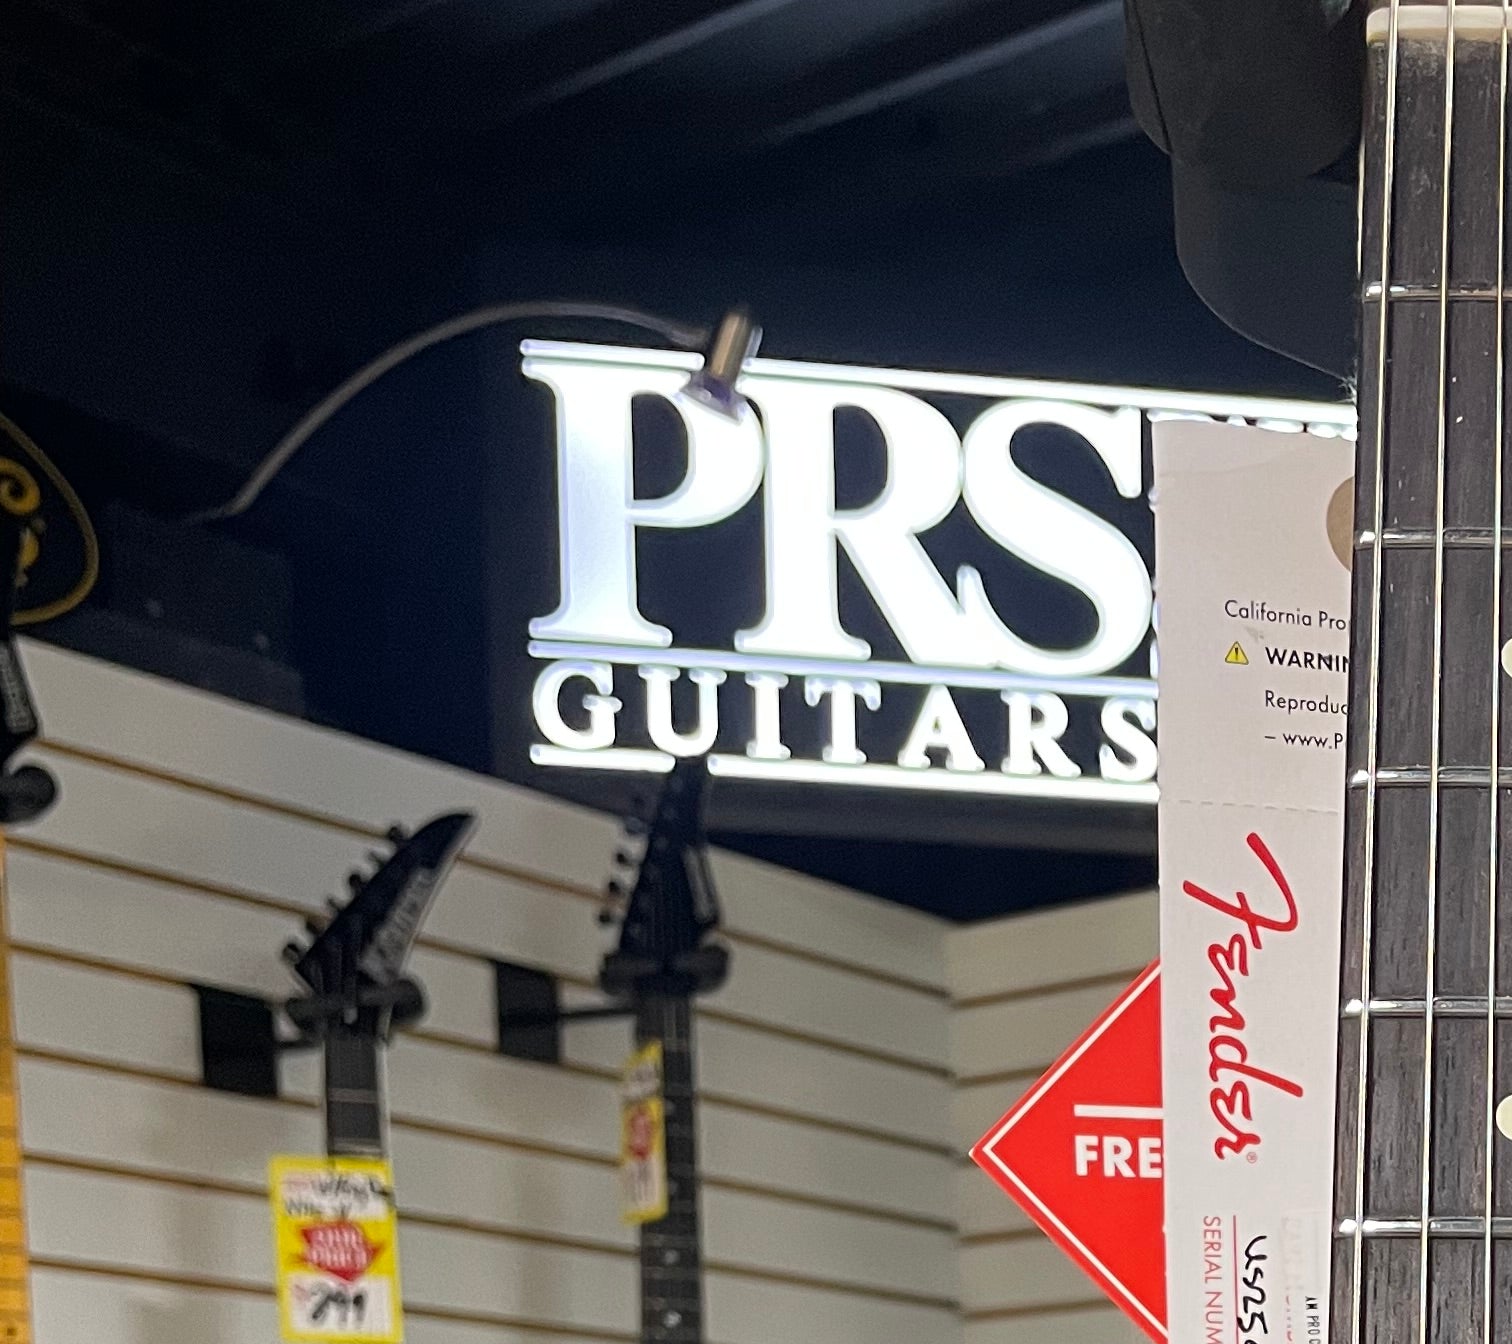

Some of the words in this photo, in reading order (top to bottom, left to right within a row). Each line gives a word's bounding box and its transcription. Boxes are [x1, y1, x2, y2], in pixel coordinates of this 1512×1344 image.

[521, 354, 1153, 678] PRS
[1224, 599, 1313, 627] California
[1318, 610, 1350, 631] Pro
[532, 658, 1159, 783] GUITARS
[1282, 732, 1344, 751] www.P
[1203, 1215, 1224, 1284] SERIAL
[1306, 1315, 1321, 1337] PRO
